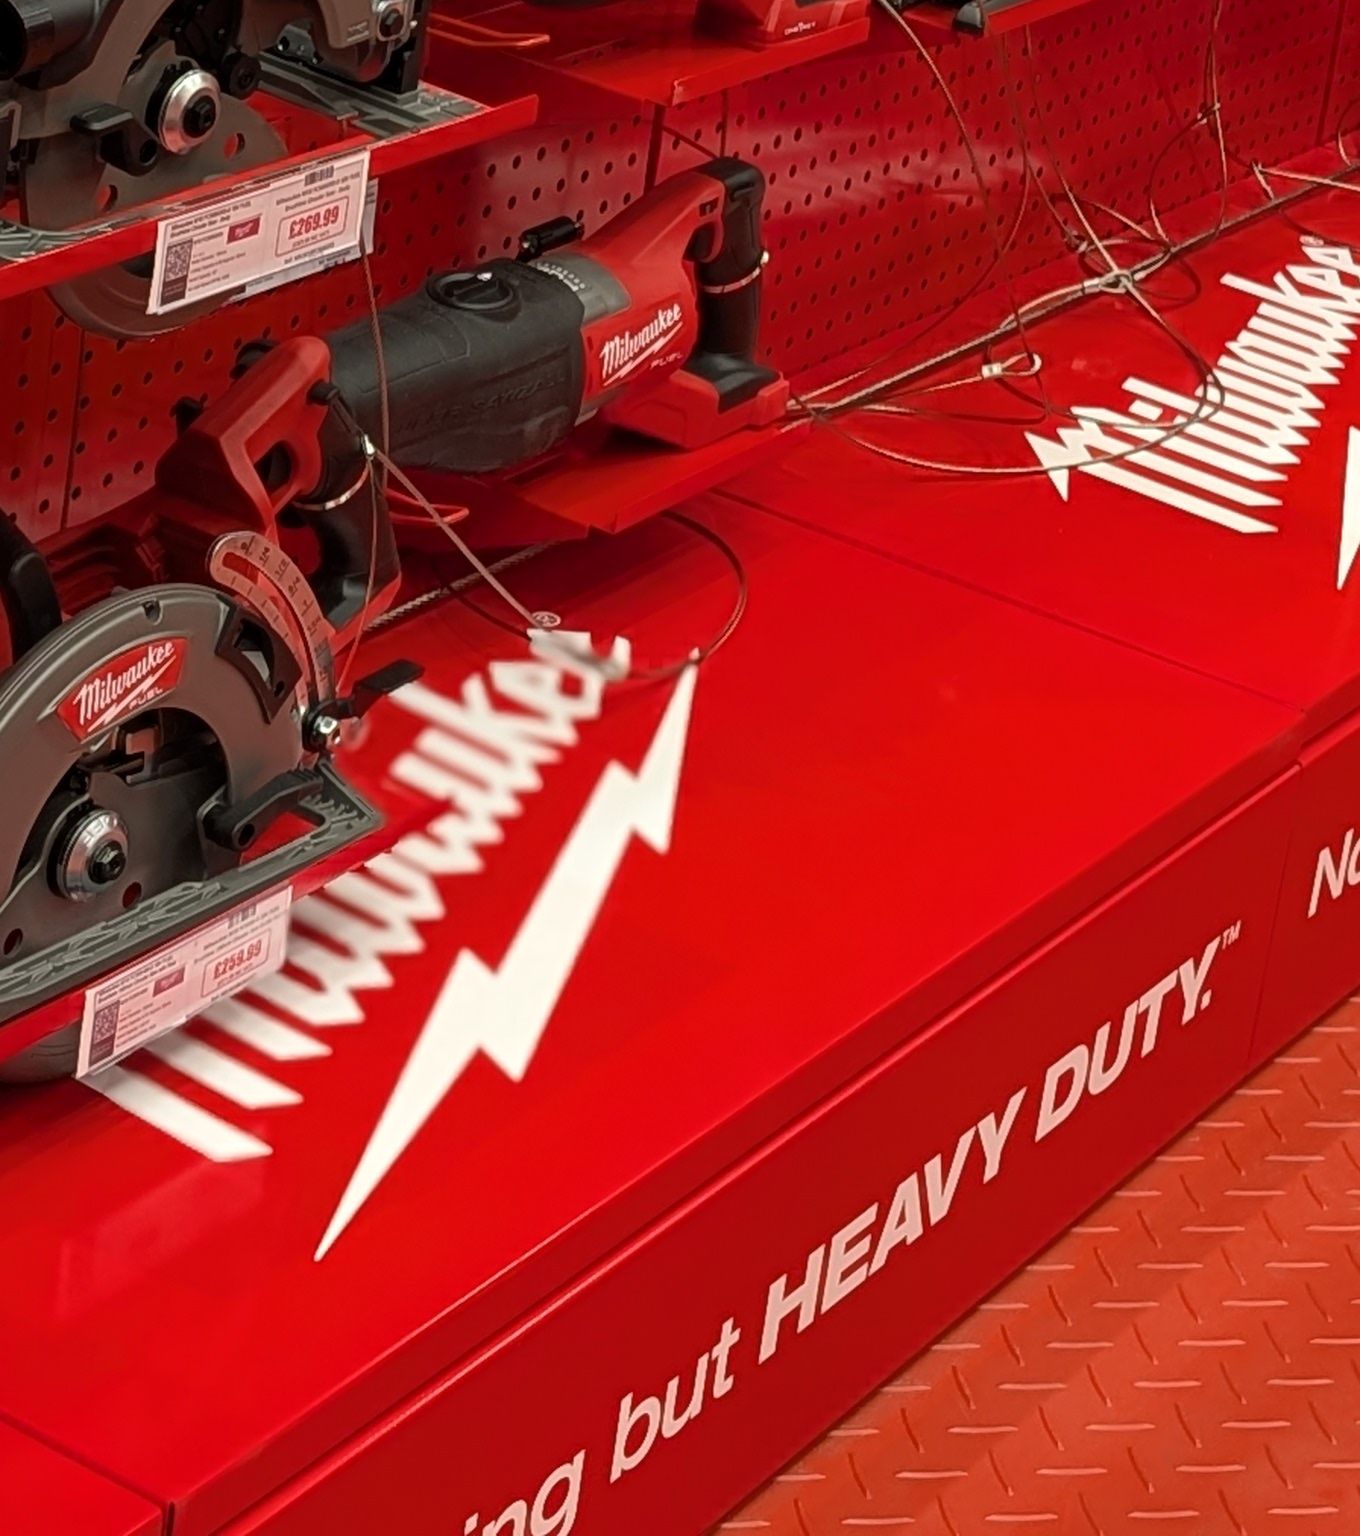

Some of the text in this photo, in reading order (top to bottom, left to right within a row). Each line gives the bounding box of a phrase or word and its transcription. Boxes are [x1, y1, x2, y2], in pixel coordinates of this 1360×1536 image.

[288, 206, 339, 240] £269.99
[599, 302, 682, 377] Milwaukee
[73, 641, 175, 726] Milwaukee
[129, 686, 163, 709] FUEL
[609, 1317, 741, 1484] but
[759, 1087, 1027, 1365] HEAVY
